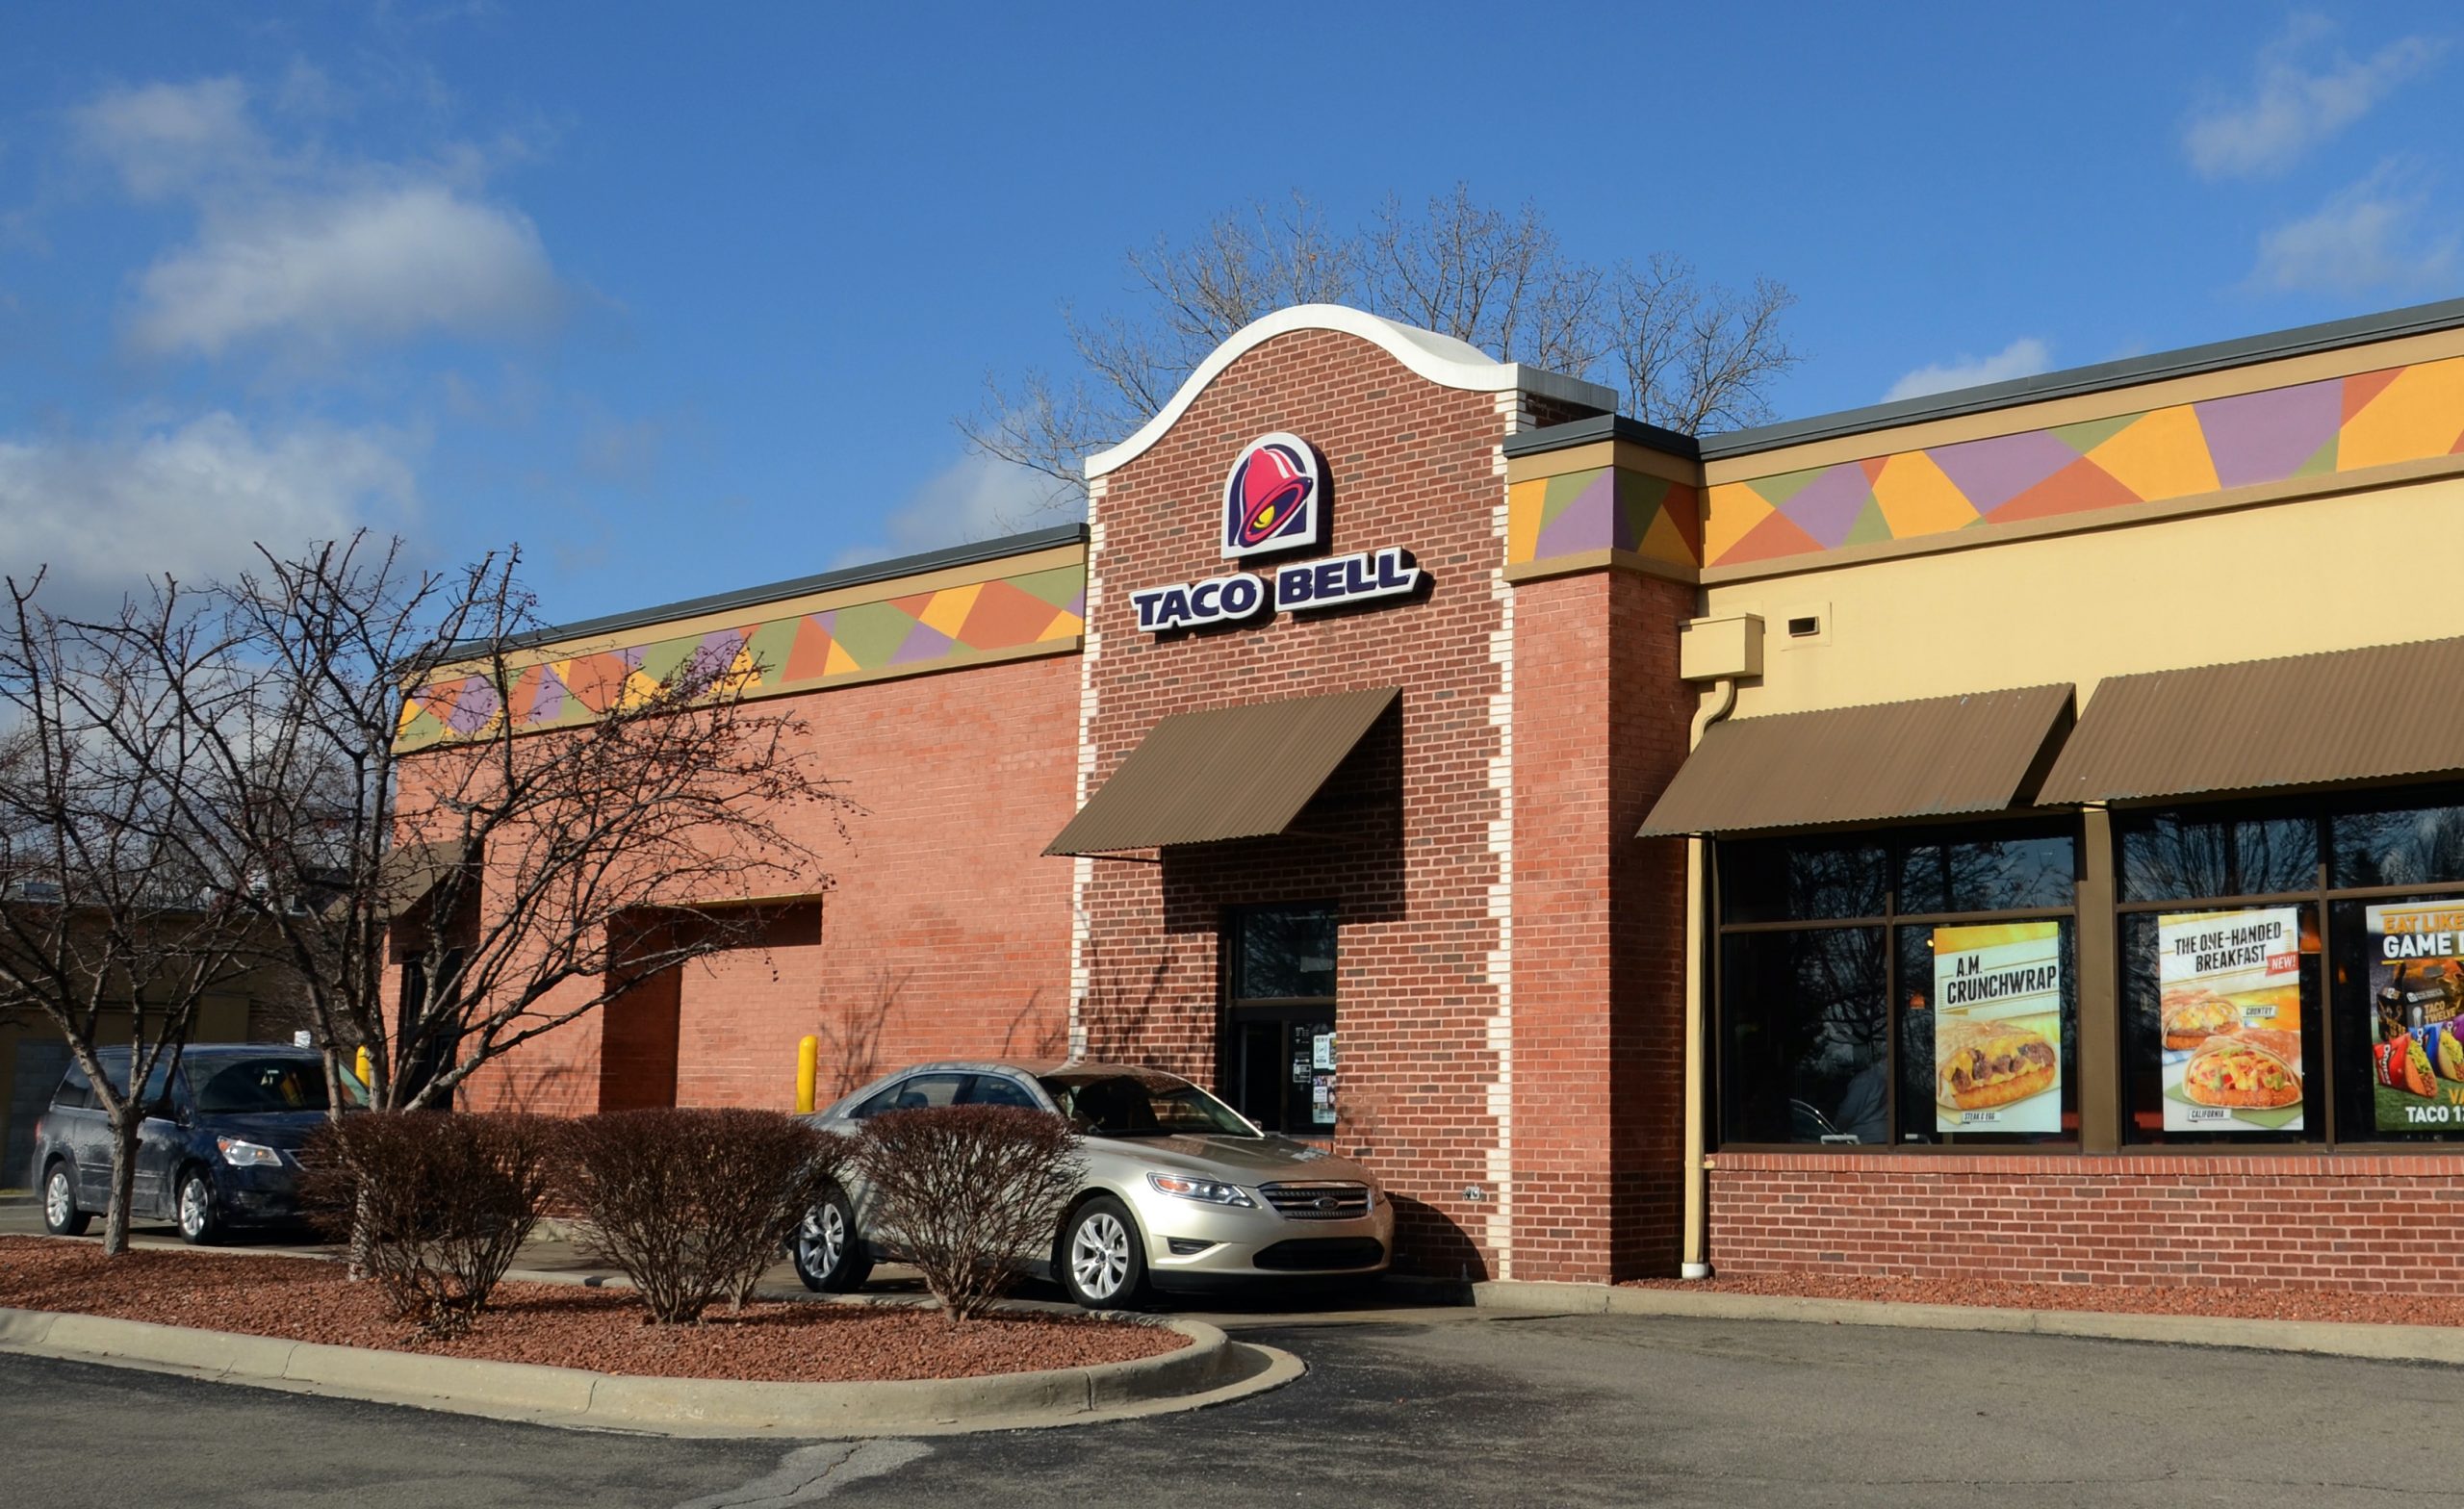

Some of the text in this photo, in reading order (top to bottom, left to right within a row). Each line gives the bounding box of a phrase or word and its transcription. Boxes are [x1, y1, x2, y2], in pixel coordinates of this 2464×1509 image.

[1132, 552, 1412, 627] TACO BELL
[2383, 916, 2418, 934] EAT
[2174, 921, 2282, 956] THE ONE-HANDED
[2382, 933, 2452, 959] GAME
[1956, 955, 1983, 978] A.M.
[2195, 943, 2267, 972] BREAKFAST
[2271, 956, 2297, 970] NEW!
[1946, 965, 2057, 1005] CRUNCHWRAP
[2424, 1001, 2446, 1014] TACO
[2405, 1105, 2464, 1123] TACO 1
